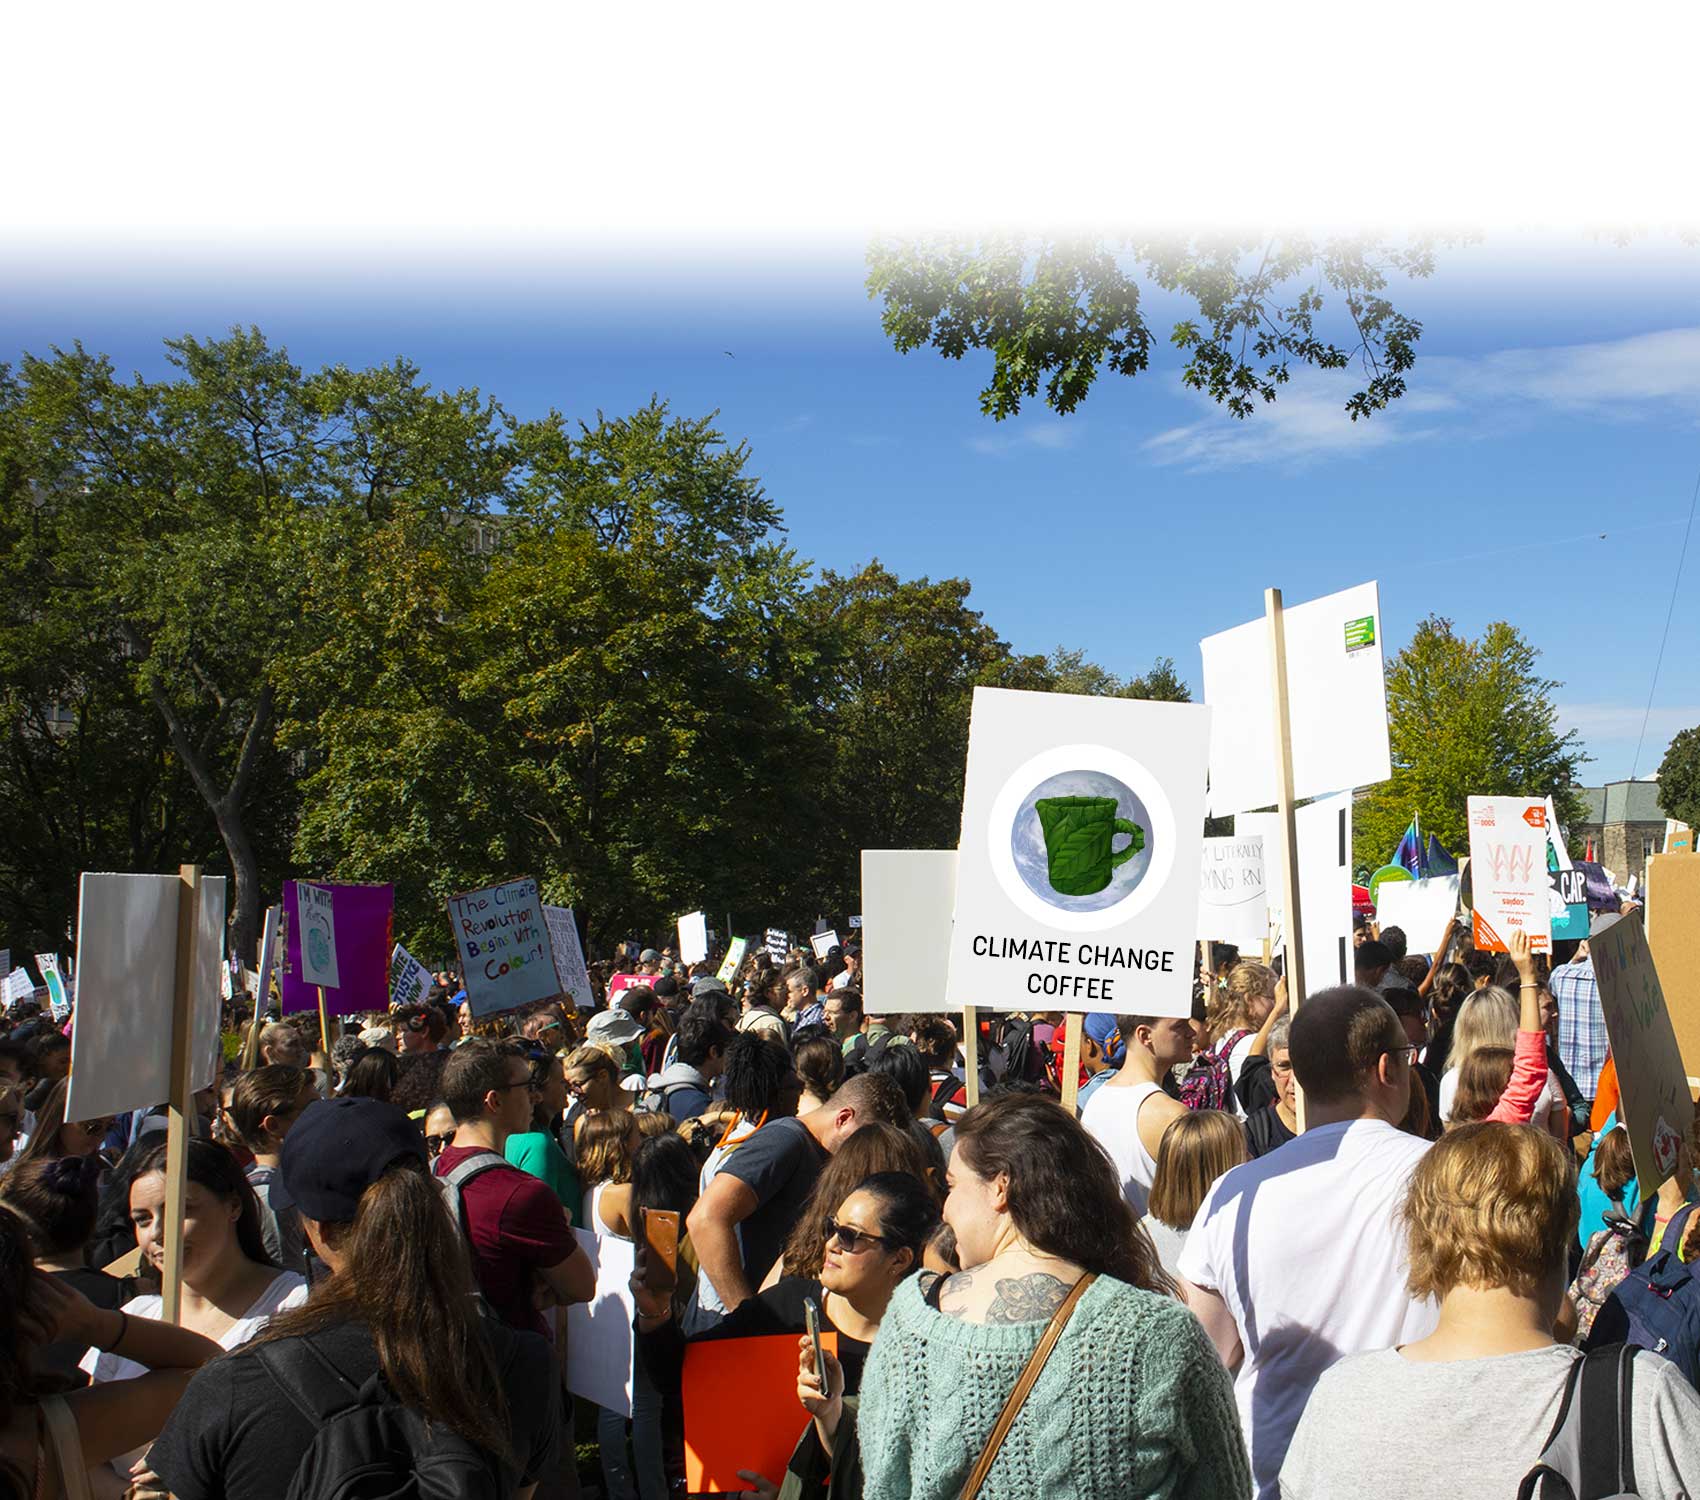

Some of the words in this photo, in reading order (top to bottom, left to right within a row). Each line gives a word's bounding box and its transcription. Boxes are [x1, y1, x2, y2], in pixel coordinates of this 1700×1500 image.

[1242, 867, 1262, 886] RN
[451, 896, 488, 917] The
[494, 884, 537, 906] Climate
[461, 909, 533, 938] Revolution
[466, 935, 510, 958] Begins
[484, 944, 544, 980] Colour!
[973, 935, 1071, 964] CLIMATE
[1078, 944, 1175, 972] CHANGE
[393, 959, 420, 1005] JUSTICE
[1027, 973, 1114, 1000] COFFEE
